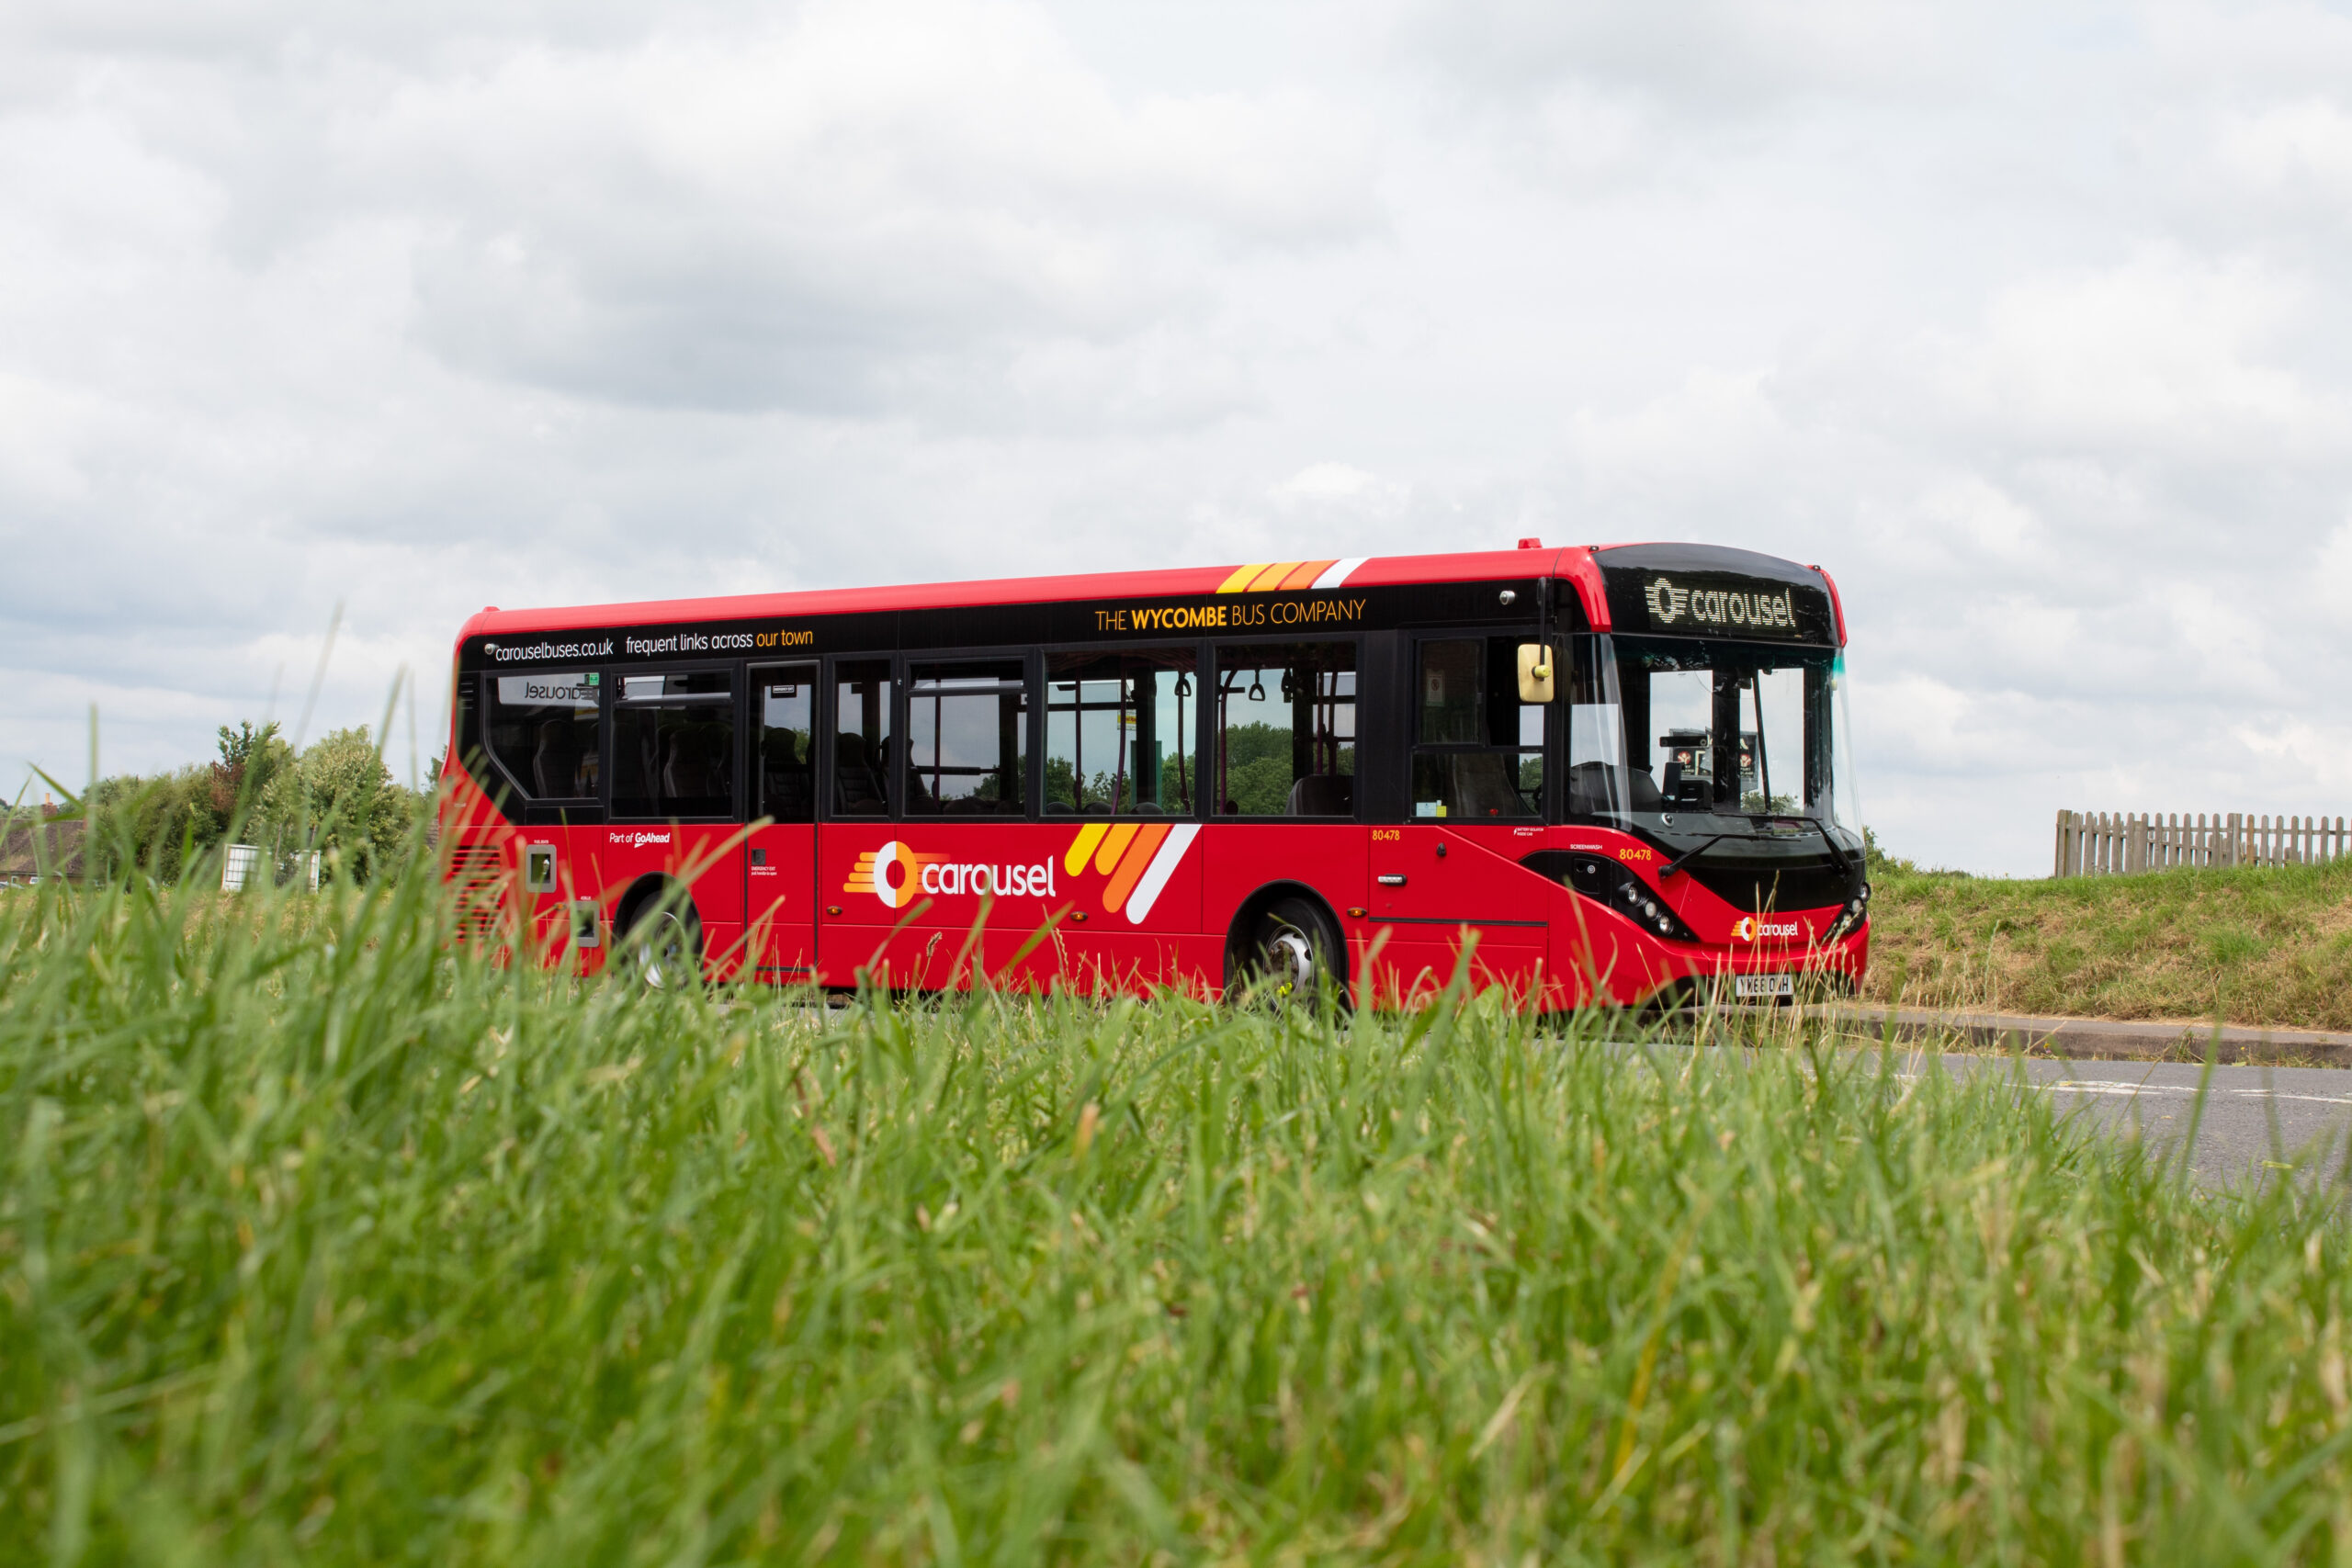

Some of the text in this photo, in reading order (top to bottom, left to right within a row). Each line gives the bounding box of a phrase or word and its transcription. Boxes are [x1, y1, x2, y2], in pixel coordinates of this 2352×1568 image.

[1095, 598, 1366, 631] THE WYCOMBE BUS COMPANY
[1691, 587, 1796, 627] carousel
[495, 637, 614, 661] carouselbuses.co.uk
[626, 629, 813, 657] frequent links across our town
[609, 831, 671, 844] Part of GoAhead
[1372, 829, 1400, 840] 80478
[1619, 848, 1652, 861] 80478
[922, 854, 1057, 897] carousel
[1758, 920, 1798, 936] carousel
